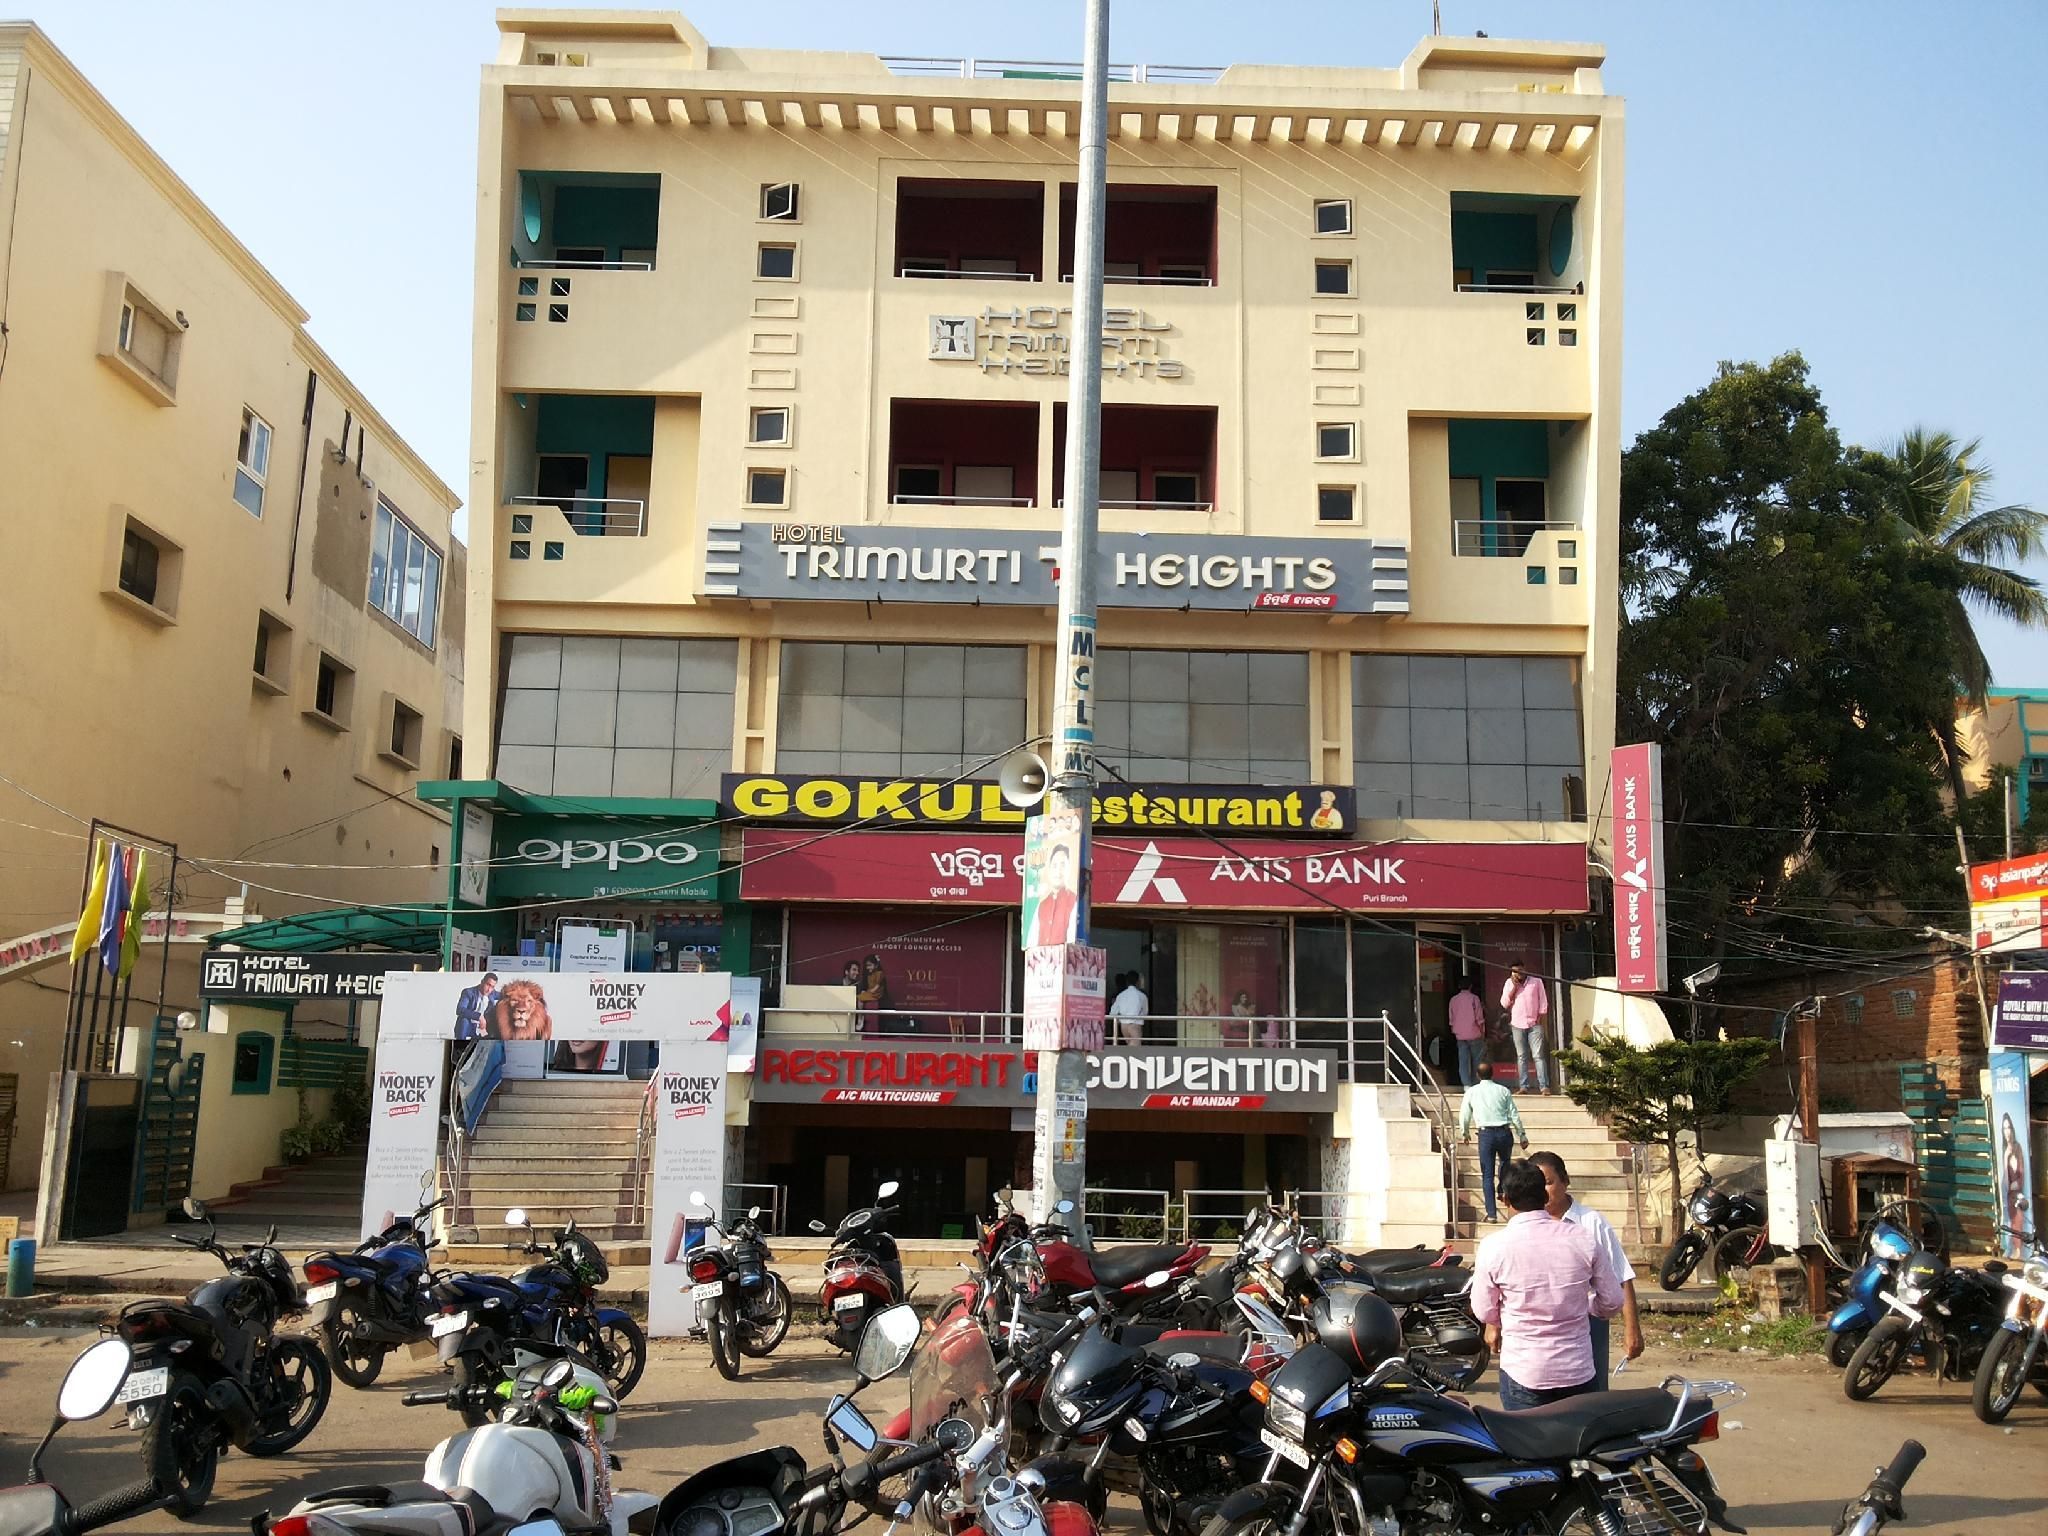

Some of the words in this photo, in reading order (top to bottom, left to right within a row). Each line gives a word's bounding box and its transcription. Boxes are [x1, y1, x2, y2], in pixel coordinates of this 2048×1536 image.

[771, 524, 846, 542] HOTEL
[778, 544, 1021, 583] TRIMURTI
[1116, 552, 1337, 590] HEIGHTS
[733, 778, 1026, 823] GOKUL
[1625, 776, 1636, 820] BANK
[1625, 824, 1637, 860] AXIS
[1210, 855, 1292, 884] AXIS
[1306, 857, 1407, 885] BANK
[1363, 894, 1379, 903] Puri
[1380, 894, 1408, 904] Branch
[243, 956, 310, 970] HOTEL
[589, 983, 646, 997] MONEY
[596, 997, 637, 1010] BACK
[763, 1049, 1016, 1087] RESTAURANT
[1085, 1055, 1328, 1093] CONVENTION
[379, 1075, 436, 1090] MONEY
[663, 1076, 721, 1091] MONEY
[385, 1089, 427, 1103] BACK
[670, 1091, 713, 1105] BACK
[836, 1090, 857, 1101] A/C
[859, 1090, 942, 1102] MULTICUISINE
[1170, 1095, 1191, 1107] A/C
[1192, 1096, 1240, 1107] MANDAP
[1375, 1413, 1414, 1421] HERO
[1371, 1420, 1420, 1429] HONDA
